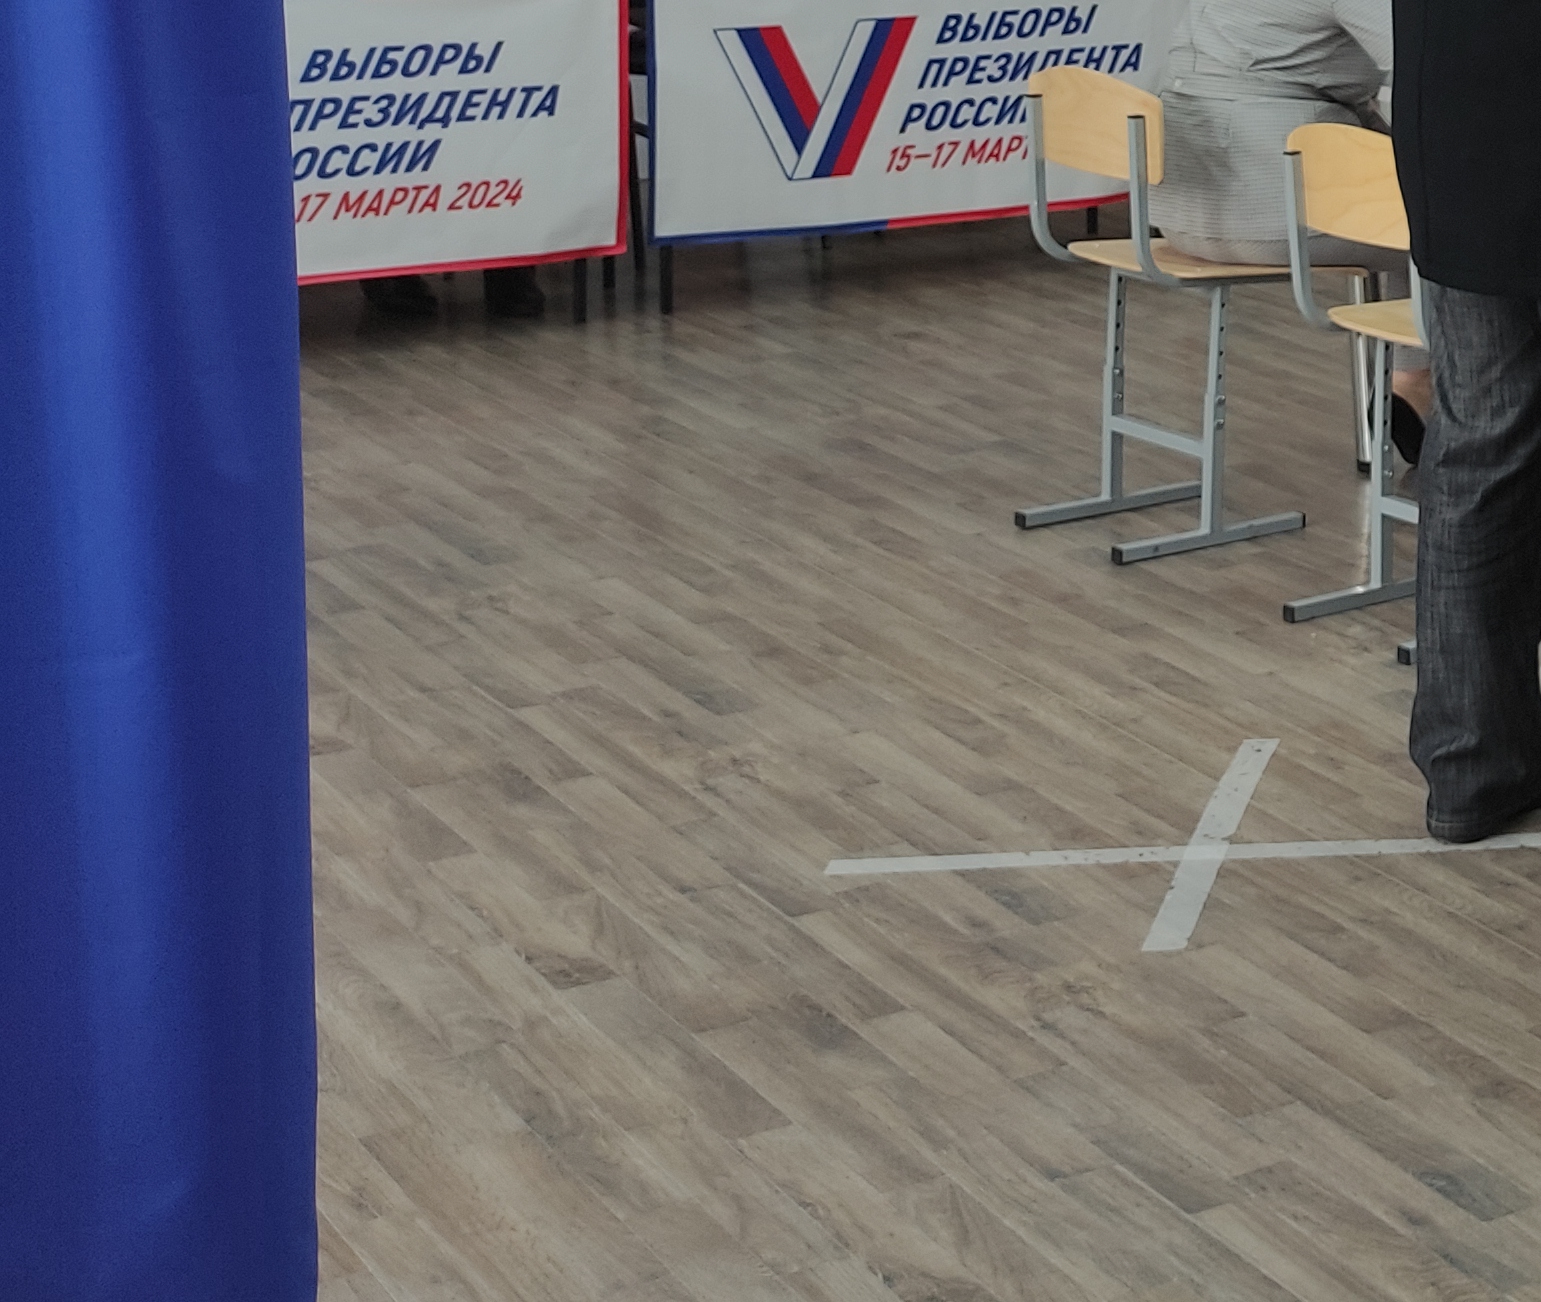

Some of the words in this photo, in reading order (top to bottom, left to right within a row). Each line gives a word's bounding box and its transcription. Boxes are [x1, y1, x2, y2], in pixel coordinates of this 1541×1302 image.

[935, 4, 1098, 45] ВЫБОРЫ
[299, 40, 505, 84] ВЫБОРЫ
[899, 94, 1028, 135] РОССИ
[292, 138, 443, 182] ОССИИ
[962, 134, 1028, 166] МАР
[294, 192, 331, 224] 17
[333, 183, 442, 221] МАРТА
[447, 178, 525, 212] 2024
